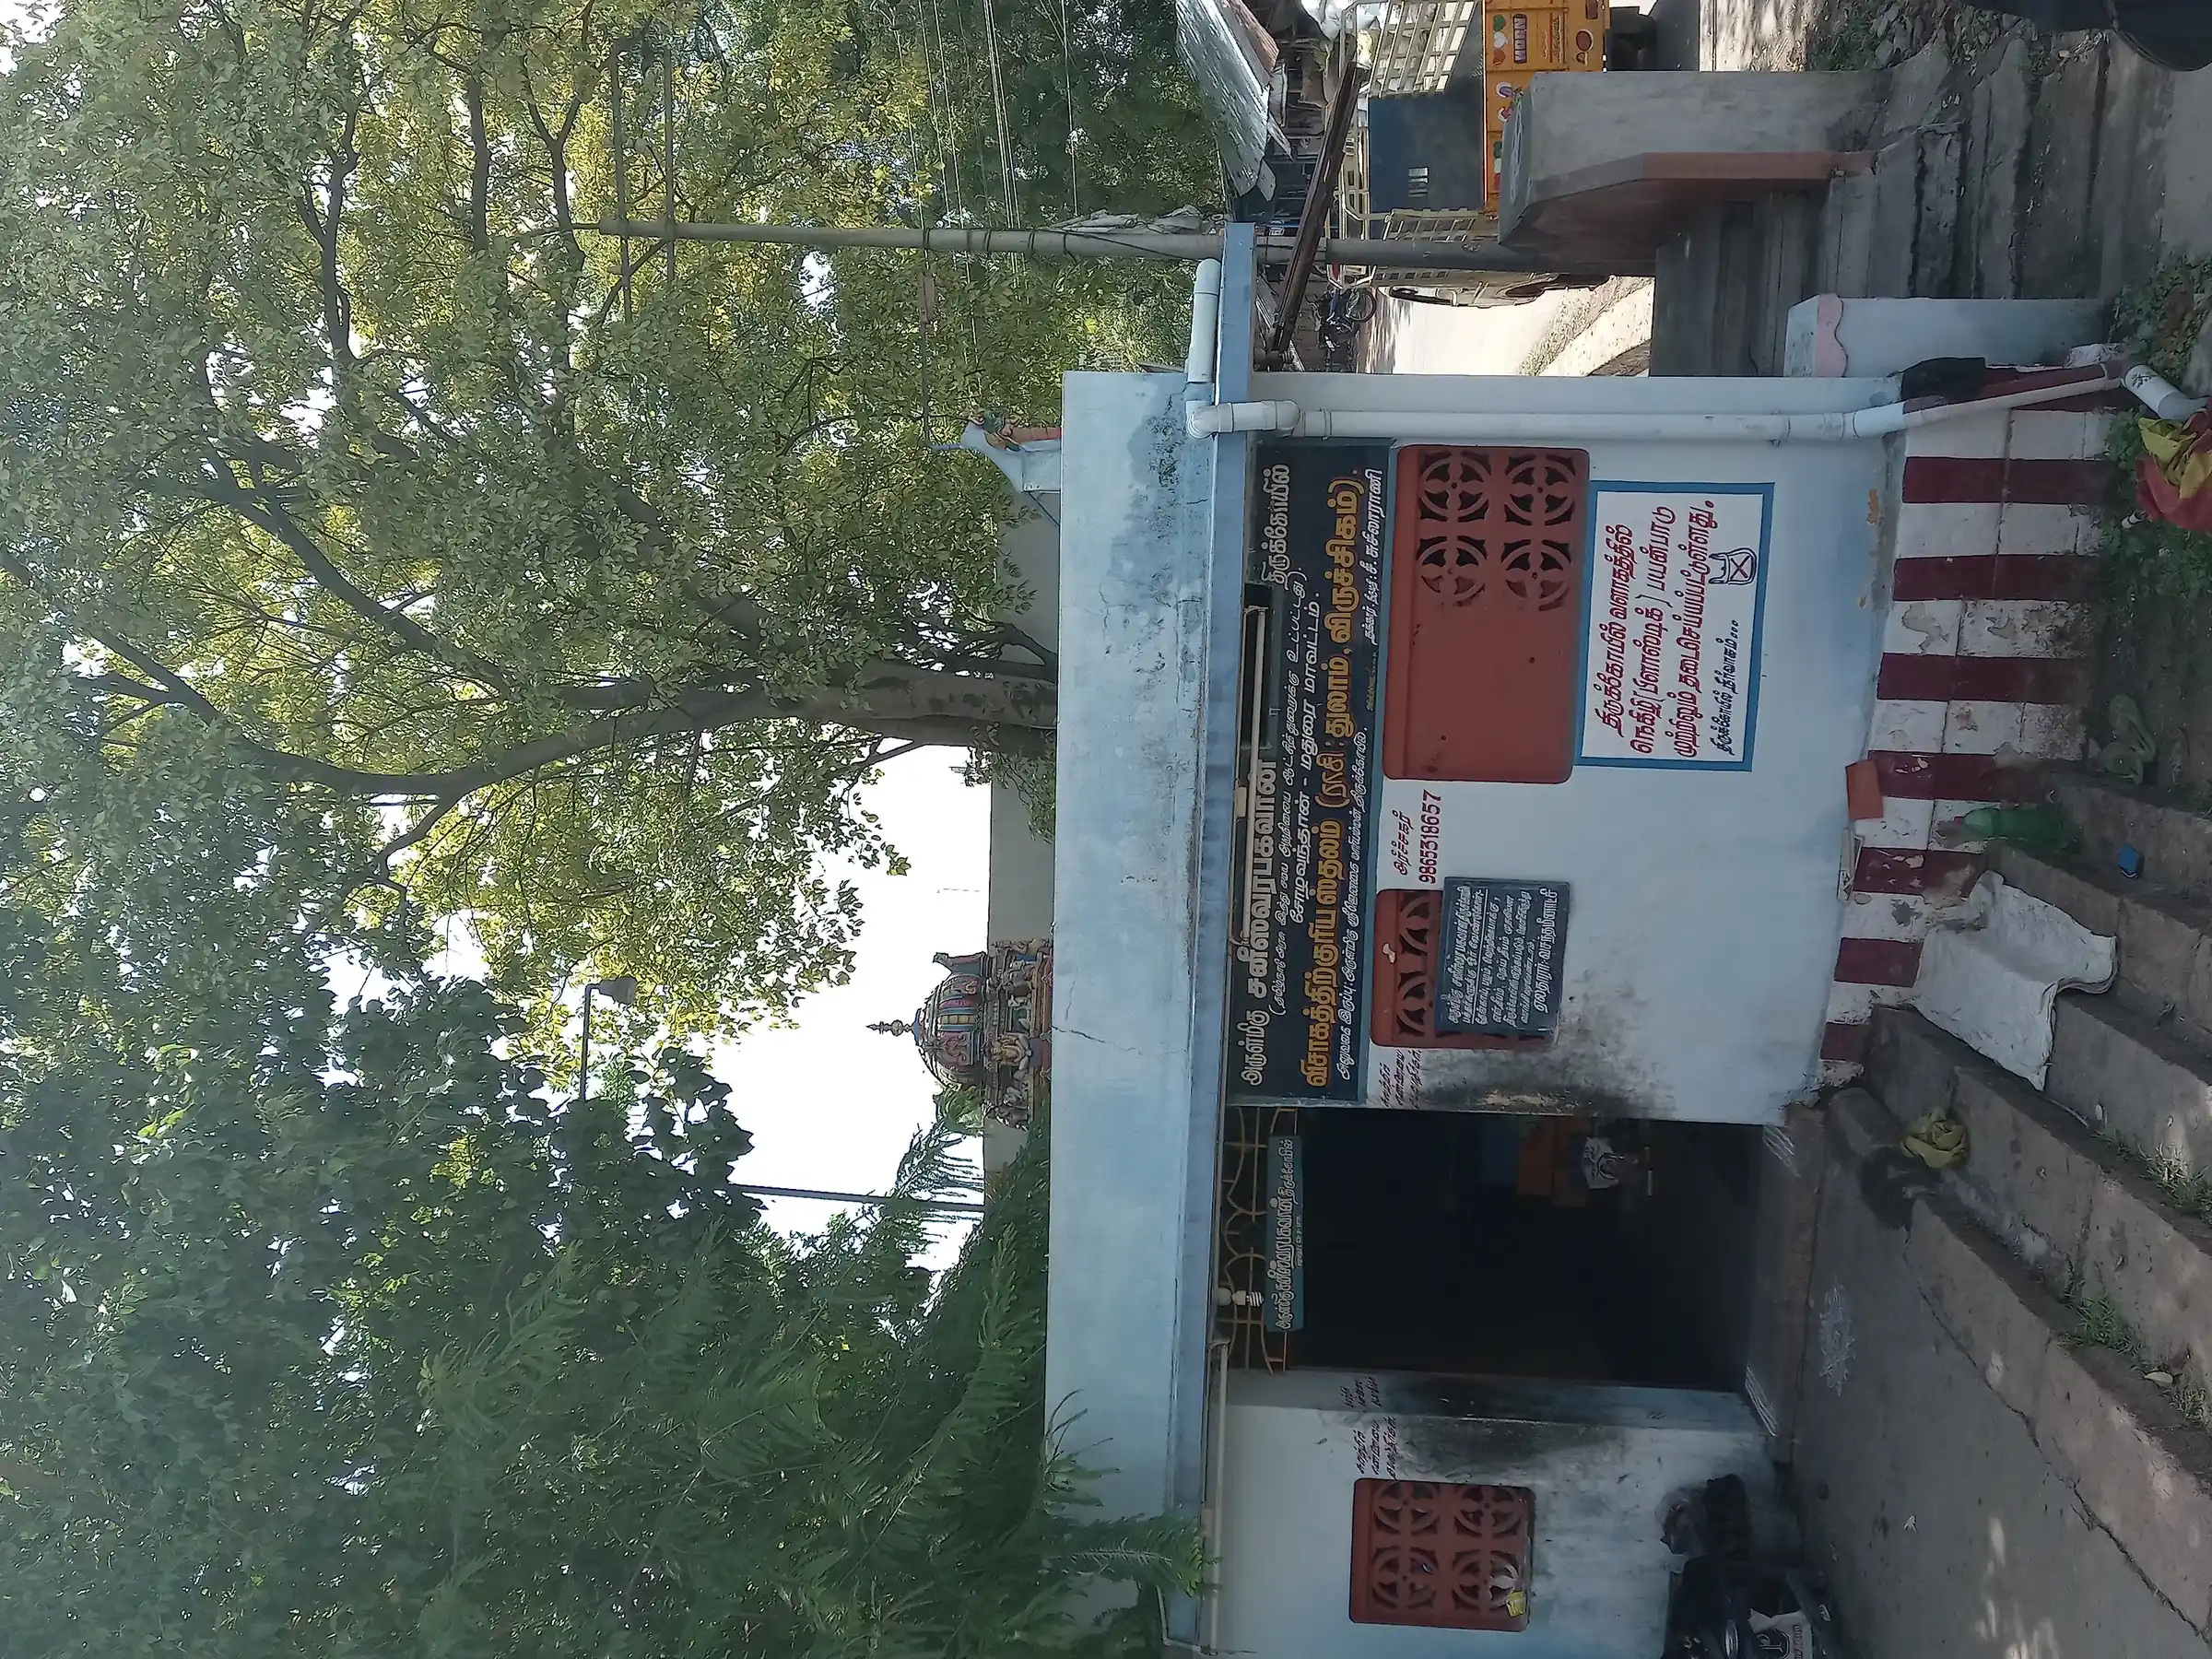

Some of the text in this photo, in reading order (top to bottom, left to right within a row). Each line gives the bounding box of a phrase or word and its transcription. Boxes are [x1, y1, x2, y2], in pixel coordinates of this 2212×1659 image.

[1513, 17, 1527, 62] HORN
[1639, 506, 1676, 592] பயன்பாடு
[1593, 524, 1634, 737] திருக்கோயில் வளாகத்தில்
[1300, 699, 1318, 771] மதுரை
[1665, 692, 1703, 758] முற்றிலும்
[1710, 691, 1735, 756] திருக்கோயில்
[1237, 1009, 1270, 1086] அருள்மிகு
[1261, 464, 1290, 590] திருக்கோயில்
[1290, 790, 1312, 924] சோழவந்தான்
[1309, 818, 1345, 904] ஸ்தலம்
[1418, 789, 1441, 884] 9865318657
[1275, 891, 1290, 925] இந்து
[1300, 909, 1339, 1087] விசாகத்திற்குரிய
